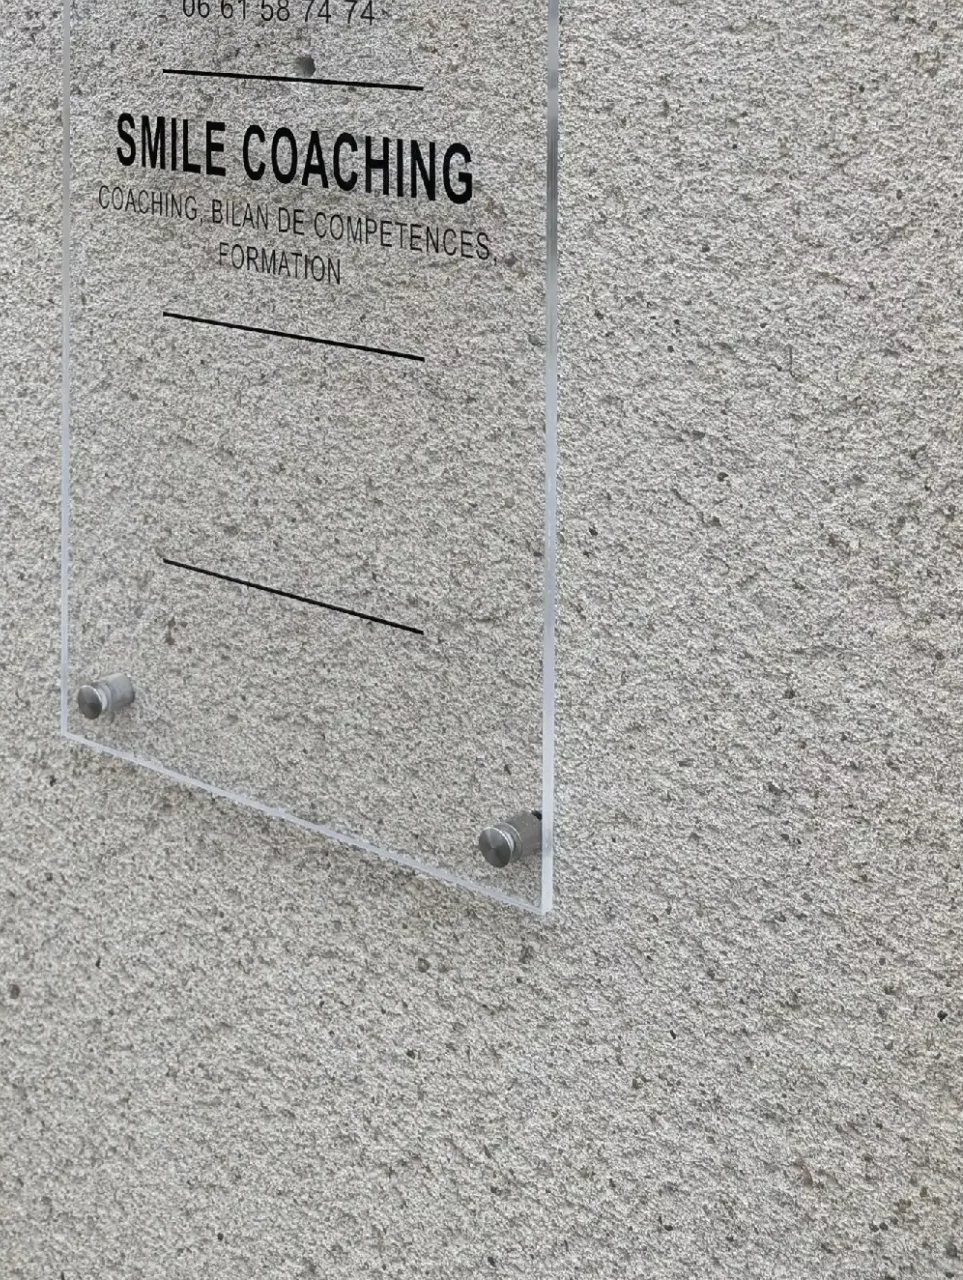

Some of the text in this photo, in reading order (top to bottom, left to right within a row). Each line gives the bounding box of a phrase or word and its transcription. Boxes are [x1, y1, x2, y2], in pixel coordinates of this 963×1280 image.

[344, 0, 375, 25] 74
[116, 112, 473, 204] SMILE COACHING
[98, 185, 498, 266] COACHING, BILAN DE COMPETENCES,
[218, 242, 341, 285] FORMATION
